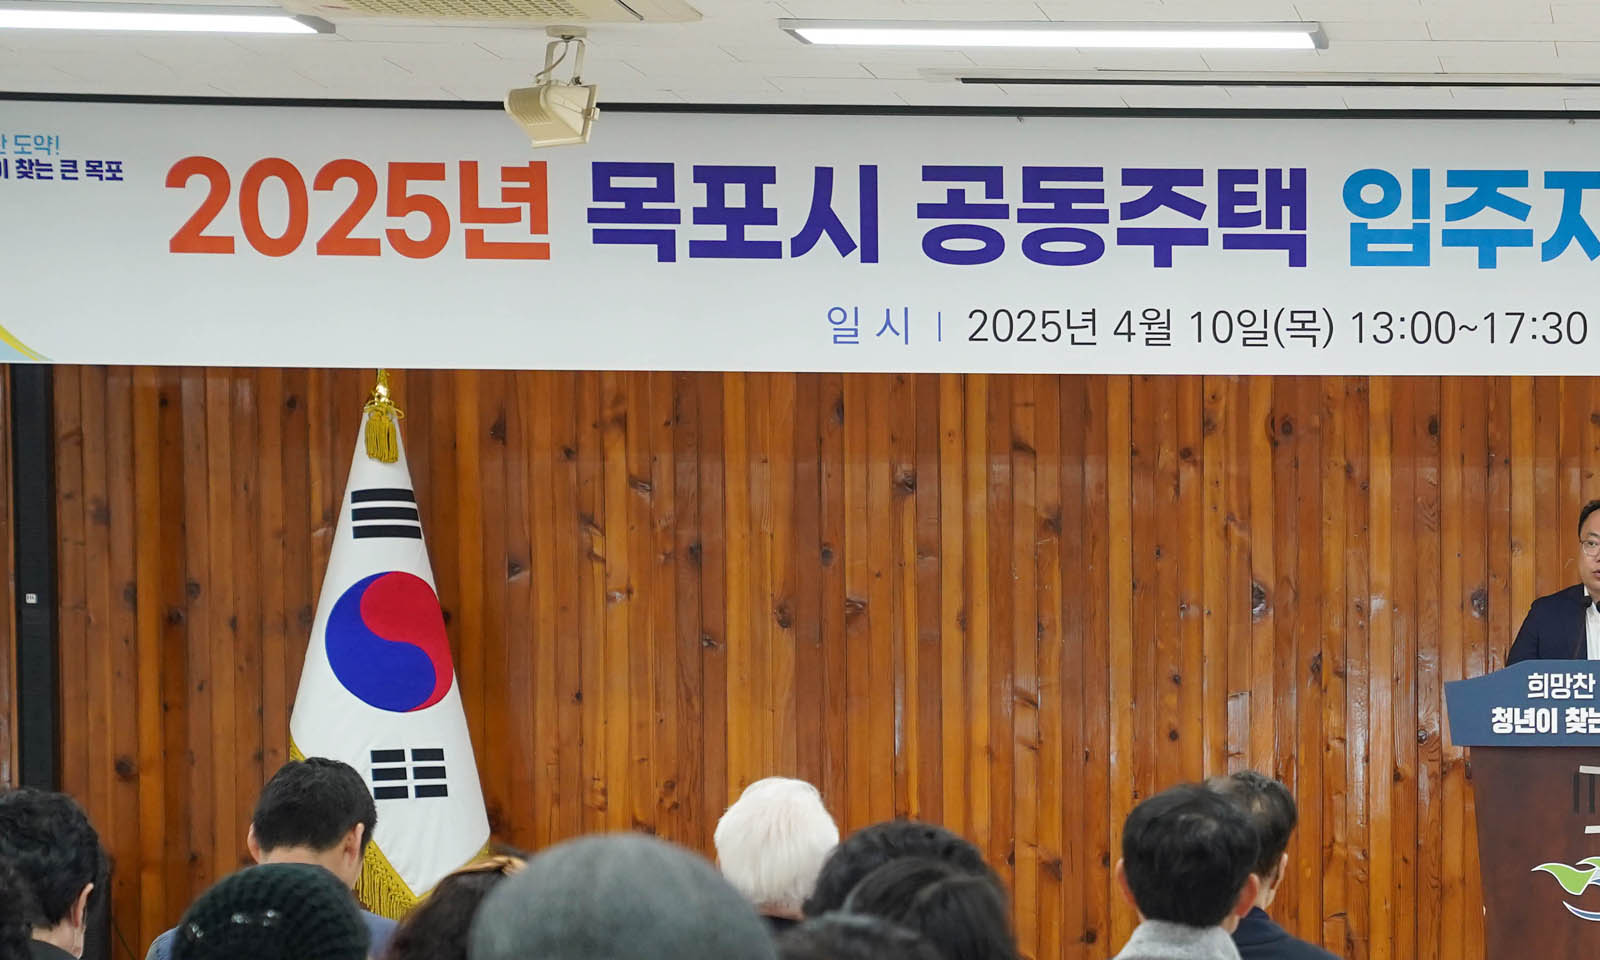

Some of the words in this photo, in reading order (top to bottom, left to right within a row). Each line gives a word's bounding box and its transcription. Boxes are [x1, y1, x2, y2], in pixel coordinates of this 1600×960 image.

[14, 134, 60, 156] 도약!
[15, 158, 54, 181] 찾는
[60, 159, 79, 181] 큰
[85, 160, 124, 182] 목포
[164, 155, 551, 261] 2025년
[586, 160, 880, 264] 목포시
[916, 163, 1308, 269] 공동주택
[967, 307, 1097, 346] 2025년
[1112, 307, 1172, 347] 4월
[1190, 306, 1334, 350] 10일(목)
[1351, 310, 1588, 345] 13:00~17:30
[1527, 672, 1596, 700] 희망찬
[1491, 706, 1559, 735] 청년이
